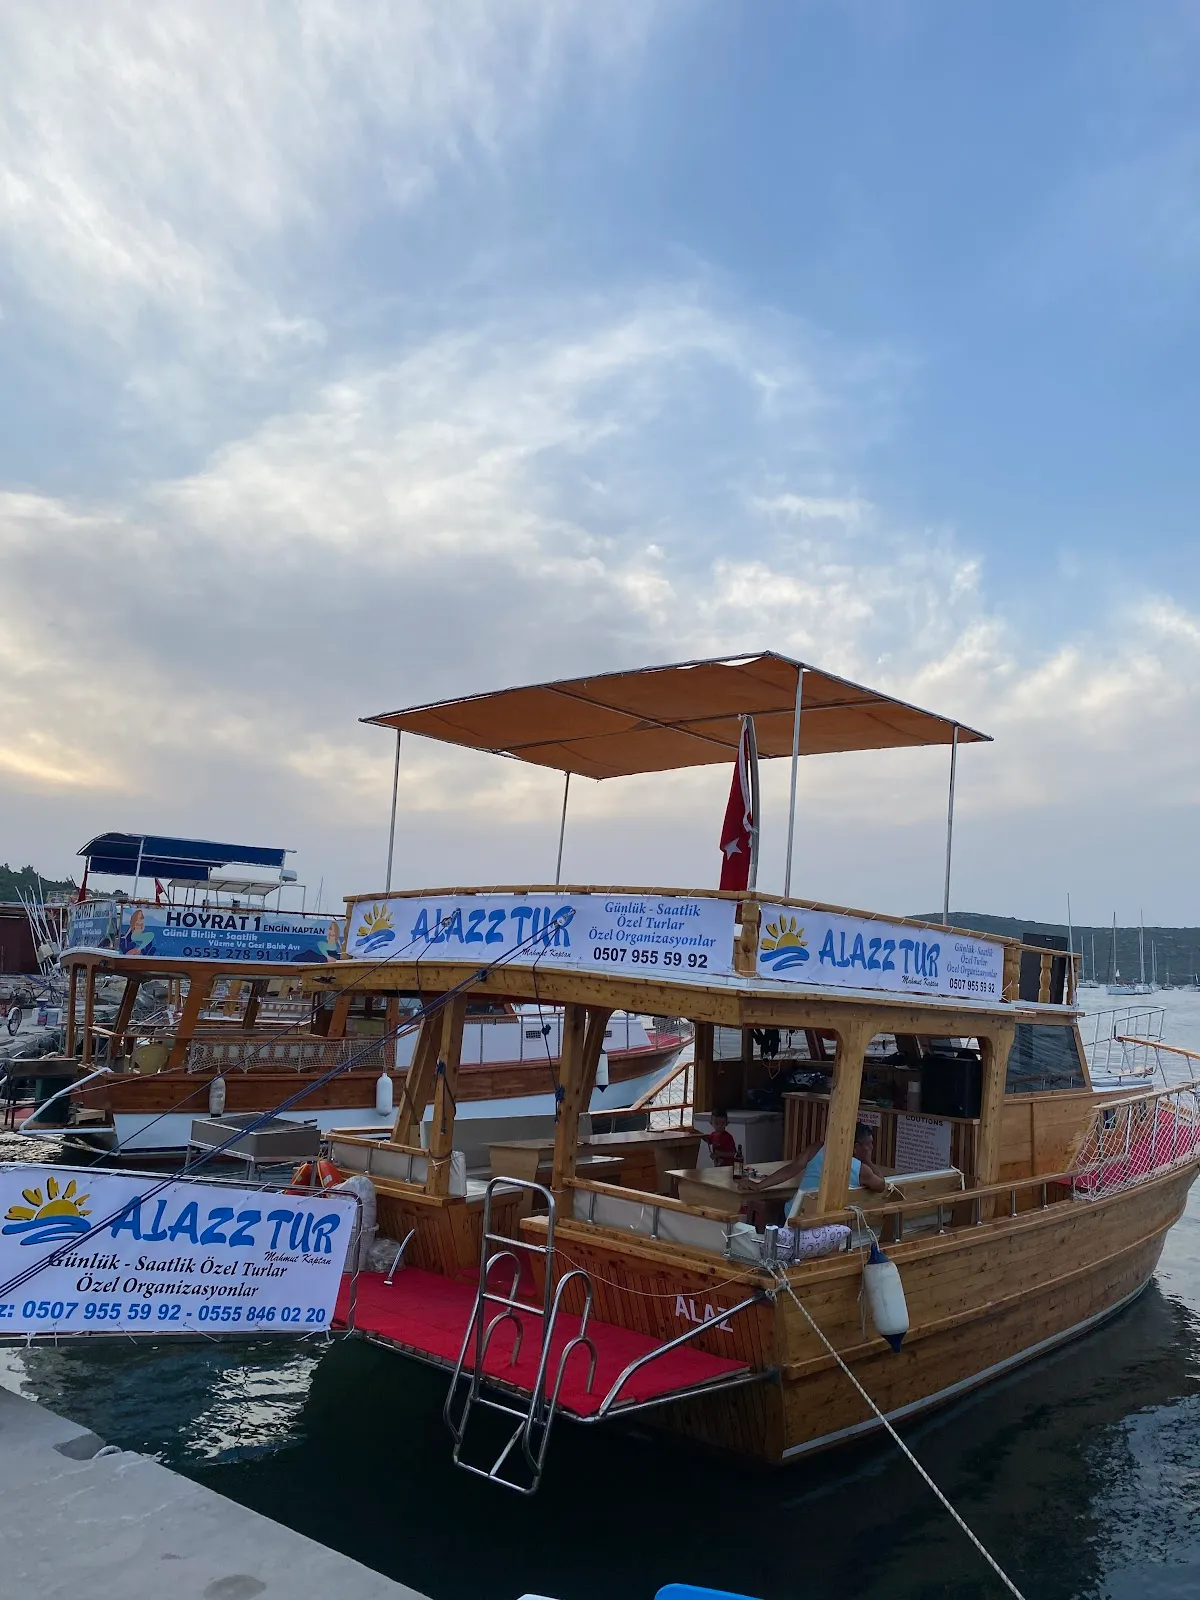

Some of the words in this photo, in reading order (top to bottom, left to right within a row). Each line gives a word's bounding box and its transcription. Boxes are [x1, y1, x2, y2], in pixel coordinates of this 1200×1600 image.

[605, 901, 646, 914] Günlük
[656, 903, 701, 916] Saatlik
[166, 911, 249, 930] HOYRAT
[254, 916, 261, 931] 1
[263, 923, 290, 933] ENGİN
[292, 926, 325, 935] KAPTAN
[411, 907, 506, 945] ALAZZ
[511, 905, 574, 947] TUR
[617, 913, 642, 928] Özel
[646, 917, 685, 930] Turlar
[162, 928, 188, 938] Günü
[191, 930, 217, 940] Birlik
[226, 932, 258, 941] Saatlik
[208, 939, 234, 948] Yüzme
[248, 941, 264, 950] Gezi
[588, 926, 613, 940] Özel
[616, 929, 716, 948] Organizasyonlar
[183, 947, 219, 958] 0553
[226, 948, 251, 960] 278
[256, 950, 270, 960] 91
[276, 951, 289, 961] 41
[593, 947, 627, 962] 0507
[631, 949, 659, 964] 955
[663, 951, 682, 966] 59
[687, 953, 708, 968] 92
[818, 928, 895, 971] ALAZZ
[899, 938, 940, 977] TUR
[950, 978, 966, 990] 0507
[967, 980, 978, 991] 955
[988, 982, 994, 993] 92
[905, 1115, 943, 1126] COUTIONS
[109, 1195, 261, 1247] ALAZZ
[266, 1209, 340, 1254] TUR
[50, 1251, 121, 1270] Günlük
[134, 1255, 196, 1273] Saatlik
[200, 1256, 239, 1276] Özel
[242, 1260, 288, 1277] Turlar
[264, 1251, 299, 1263] Mahmut
[301, 1253, 332, 1266] Kaptan
[76, 1272, 120, 1293] Özel
[122, 1277, 259, 1300] Organizasyonlar
[22, 1300, 78, 1319] 0507
[83, 1302, 121, 1320] 955
[127, 1303, 152, 1320] 59
[157, 1304, 182, 1321] 92
[198, 1305, 242, 1322] 0555
[246, 1306, 276, 1322] 846
[281, 1306, 301, 1323] 02
[305, 1308, 326, 1323] 20
[675, 1295, 733, 1332] ALAZ
